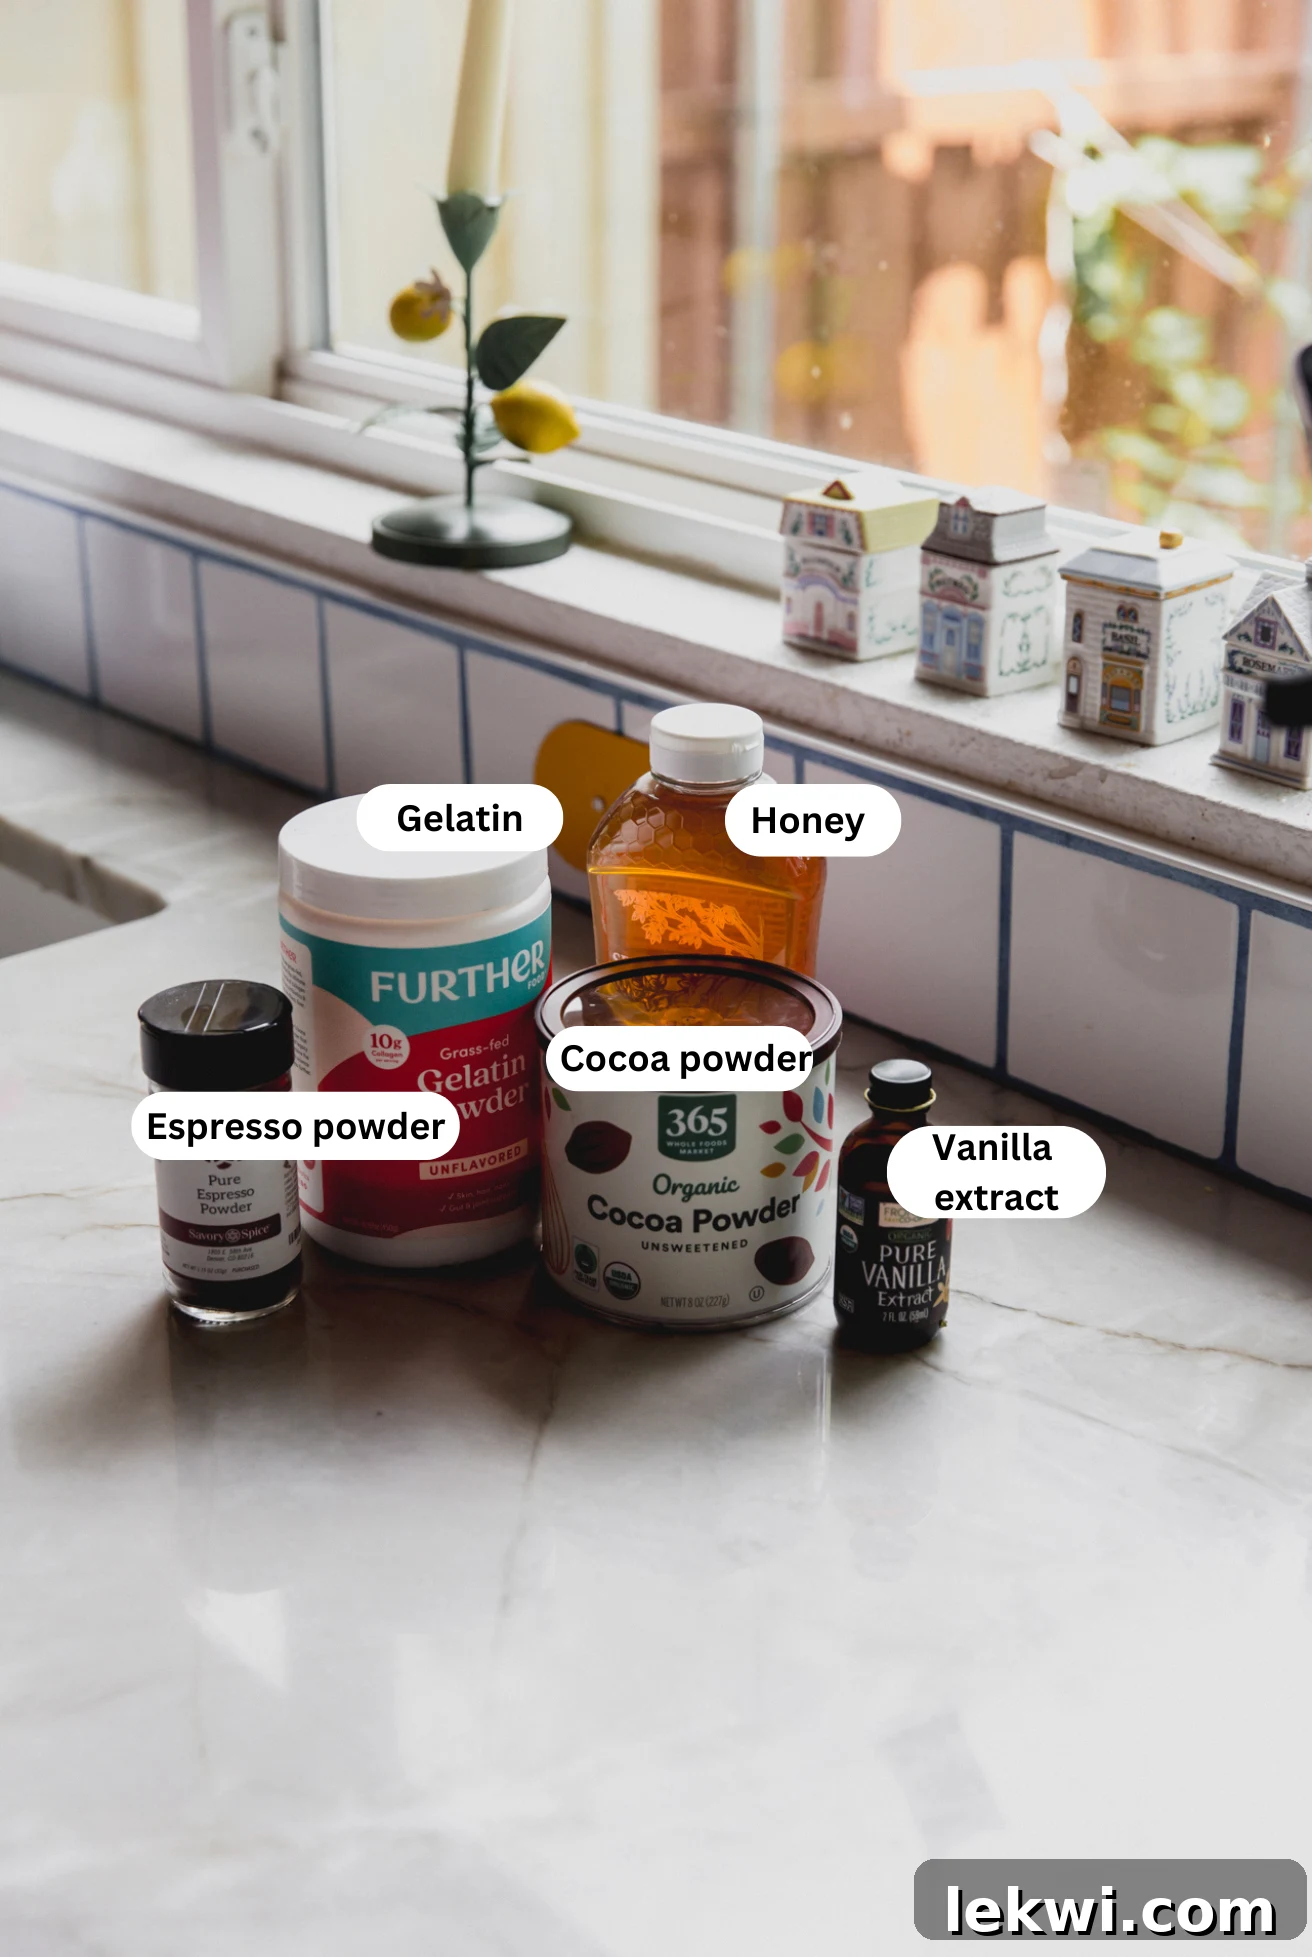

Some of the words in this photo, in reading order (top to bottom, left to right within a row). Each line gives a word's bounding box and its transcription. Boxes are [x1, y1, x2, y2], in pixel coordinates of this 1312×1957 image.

[370, 1033, 402, 1051] 10g
[440, 1034, 510, 1060] Grass-fed
[371, 1050, 404, 1060] Collagen
[417, 1053, 526, 1093] Gelatin
[456, 1082, 530, 1121] wder
[665, 1105, 728, 1138] 365
[666, 1140, 696, 1148] WHOLE
[429, 1145, 521, 1176] UNFLAVORED
[208, 1174, 241, 1186] Pure
[652, 1173, 740, 1203] Organic
[196, 1187, 255, 1203] Espresso
[200, 1202, 252, 1215] Powder
[587, 1194, 683, 1233] Cocoa
[692, 1194, 801, 1233] Powder
[188, 1228, 224, 1242] Savory
[241, 1224, 270, 1241] Spice
[641, 1238, 748, 1253] UNSWEETENED
[880, 1240, 937, 1264] PURE
[862, 1255, 946, 1290] VANILLA
[660, 1297, 674, 1307] NET
[675, 1297, 687, 1307] WT
[687, 1297, 694, 1307] 8
[706, 1295, 730, 1307] (227g)
[878, 1286, 935, 1308] Extract
